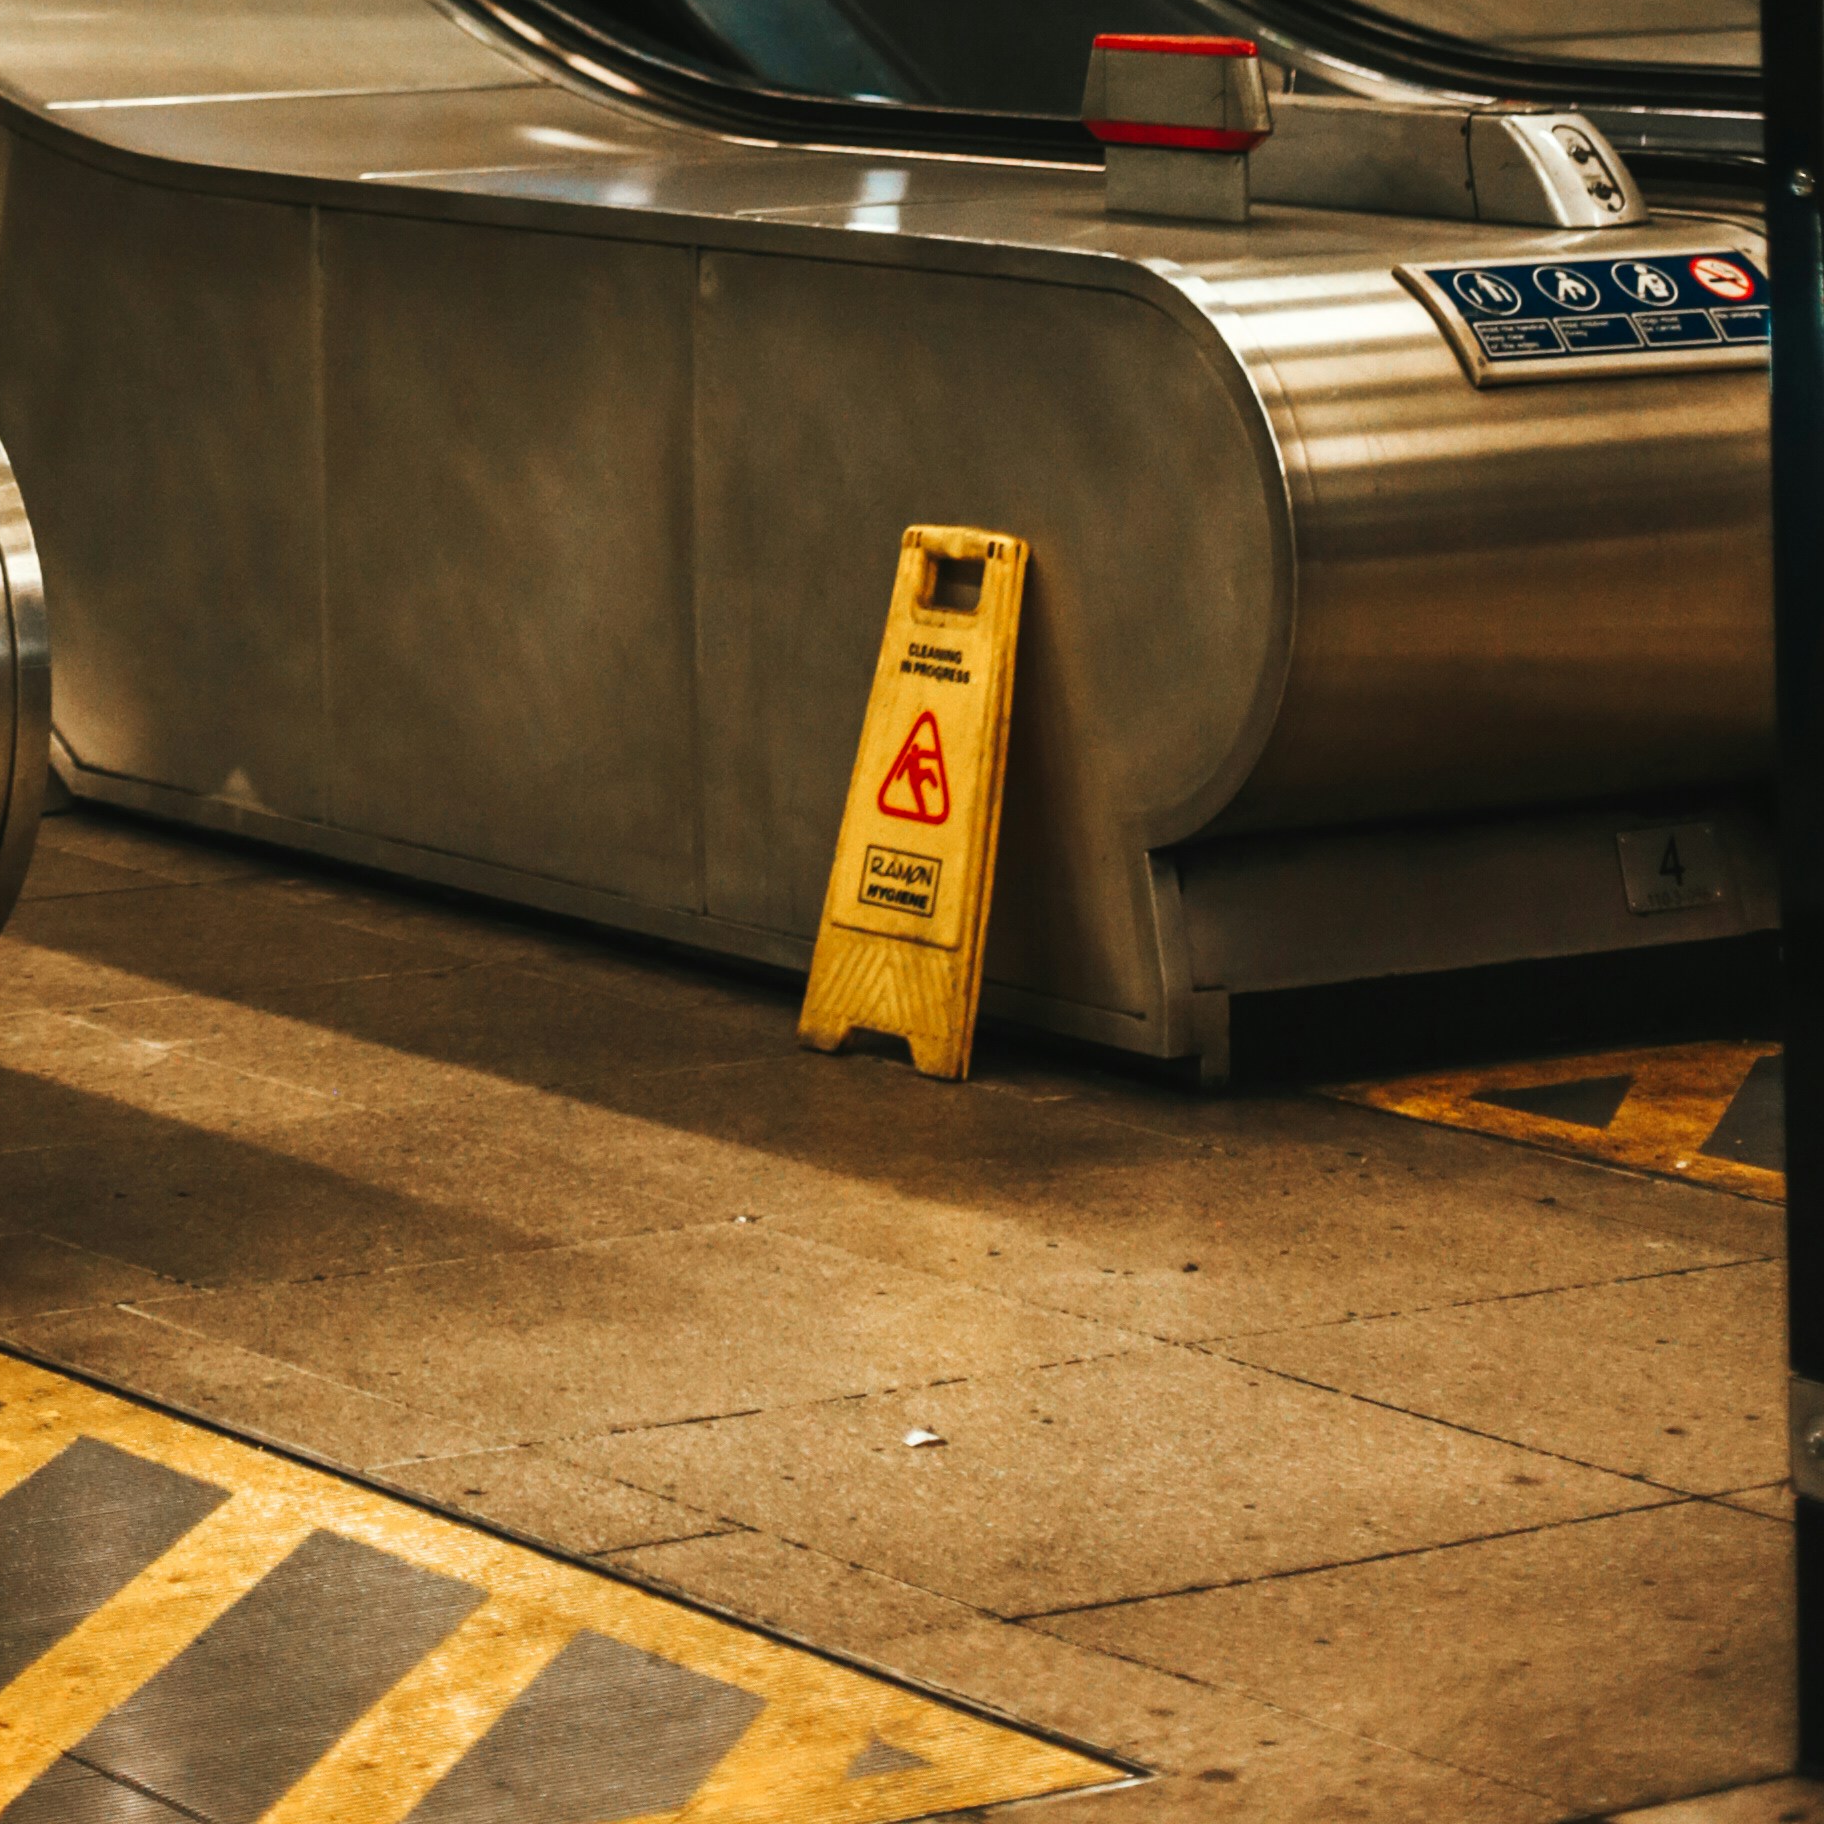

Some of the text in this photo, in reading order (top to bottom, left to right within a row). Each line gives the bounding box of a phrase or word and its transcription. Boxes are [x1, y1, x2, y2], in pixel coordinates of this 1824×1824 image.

[908, 643, 962, 664] CLEANING
[900, 660, 970, 684] IN PROGRESS
[1659, 836, 1686, 886] 4
[867, 884, 929, 910] HYGIENE
